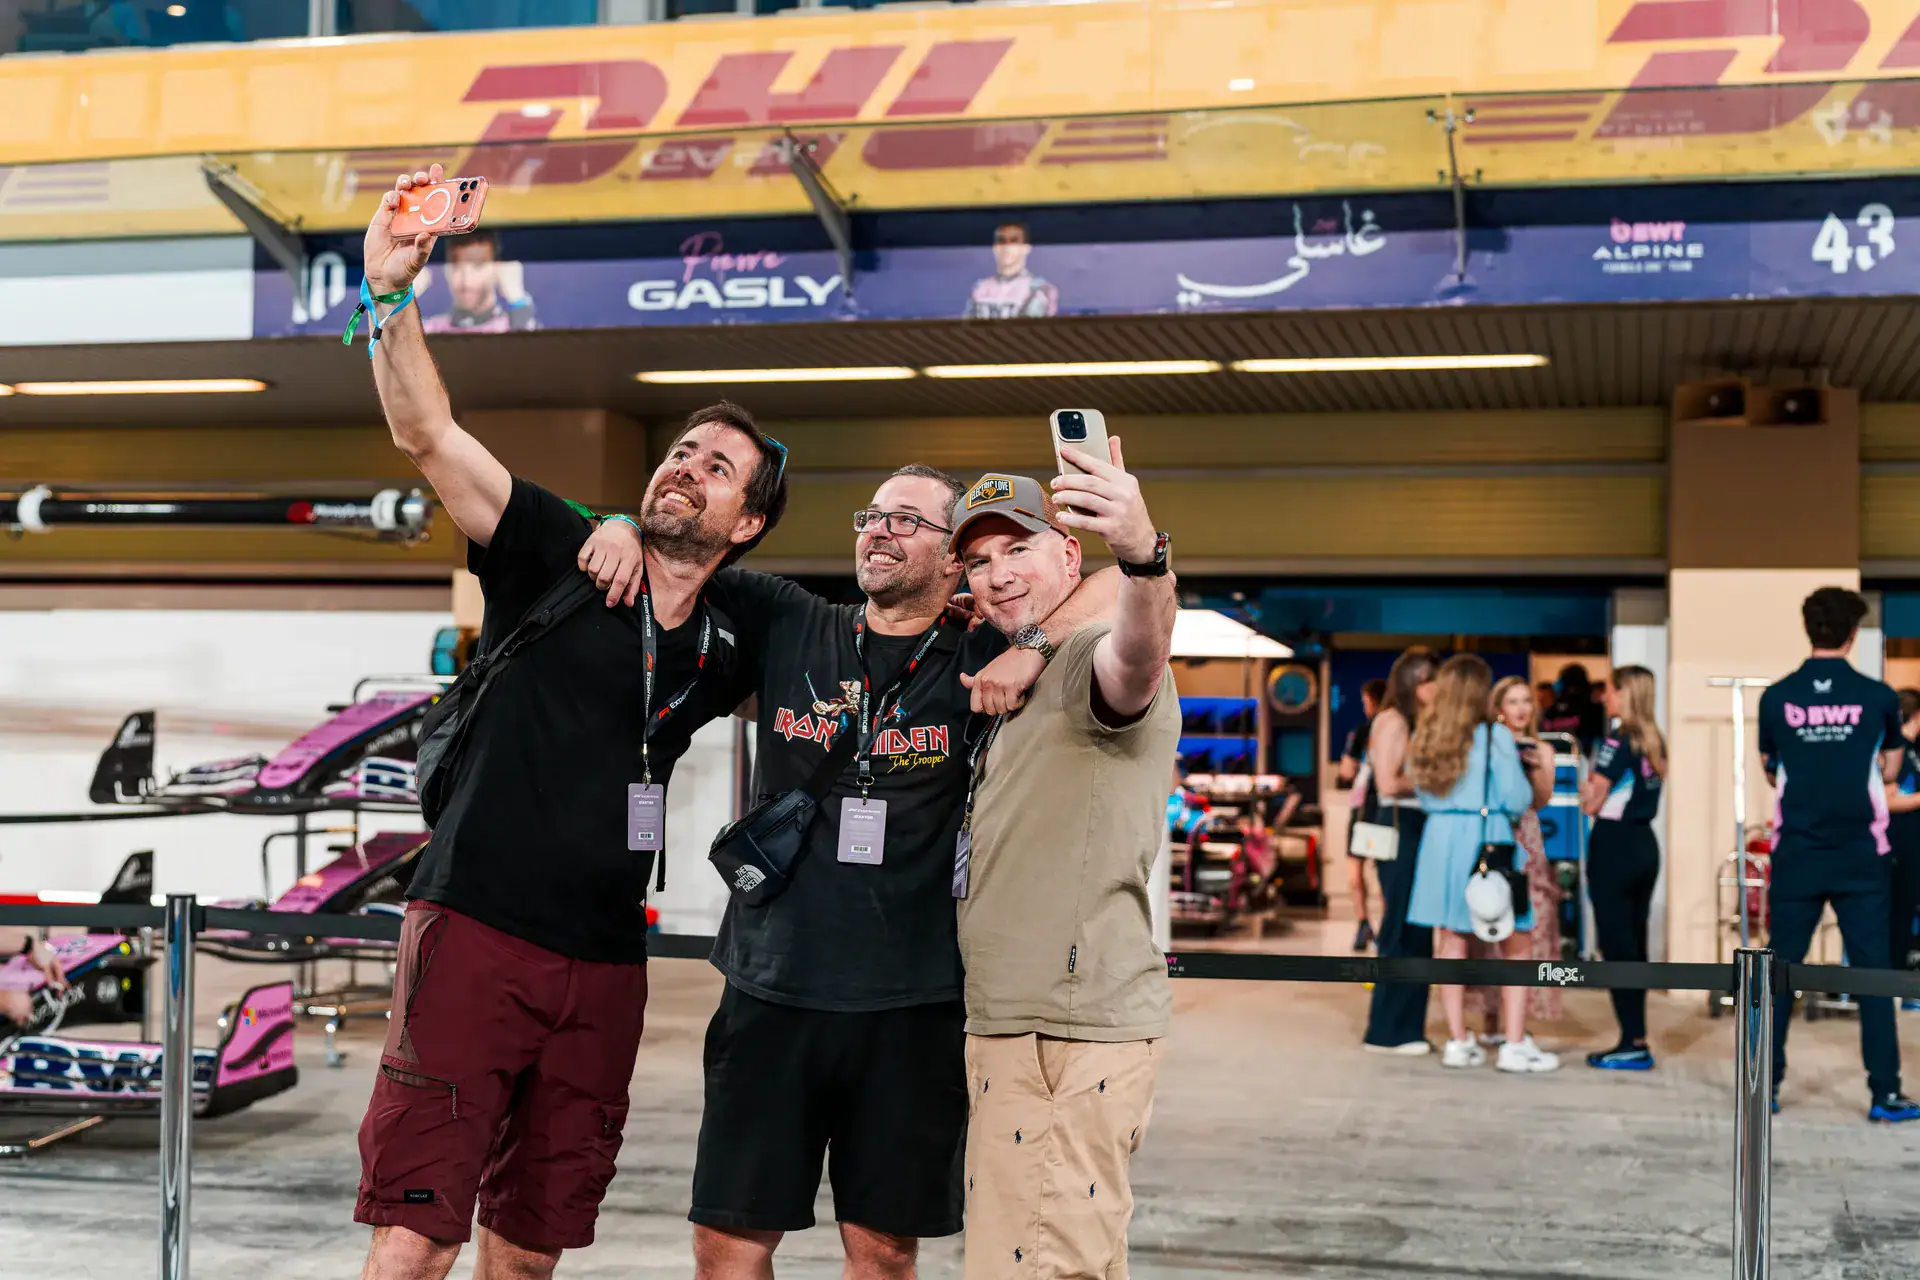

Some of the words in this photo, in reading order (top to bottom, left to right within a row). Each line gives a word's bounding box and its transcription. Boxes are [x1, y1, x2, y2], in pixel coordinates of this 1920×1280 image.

[453, 38, 1050, 185] DHL
[1592, 243, 1704, 260] ALPINE
[1811, 203, 1895, 274] 43
[627, 273, 843, 311] GASLY
[995, 480, 1009, 491] LOVE
[642, 595, 652, 637] Experiences
[915, 630, 939, 661] Experiences
[862, 691, 871, 734] Experiences
[1807, 704, 1863, 726] BWT
[774, 707, 839, 752] IRON
[887, 754, 909, 773] The
[907, 752, 945, 772] Trooper
[734, 872, 754, 890] NORTH
[735, 866, 748, 878] THE
[742, 878, 758, 893] FACE
